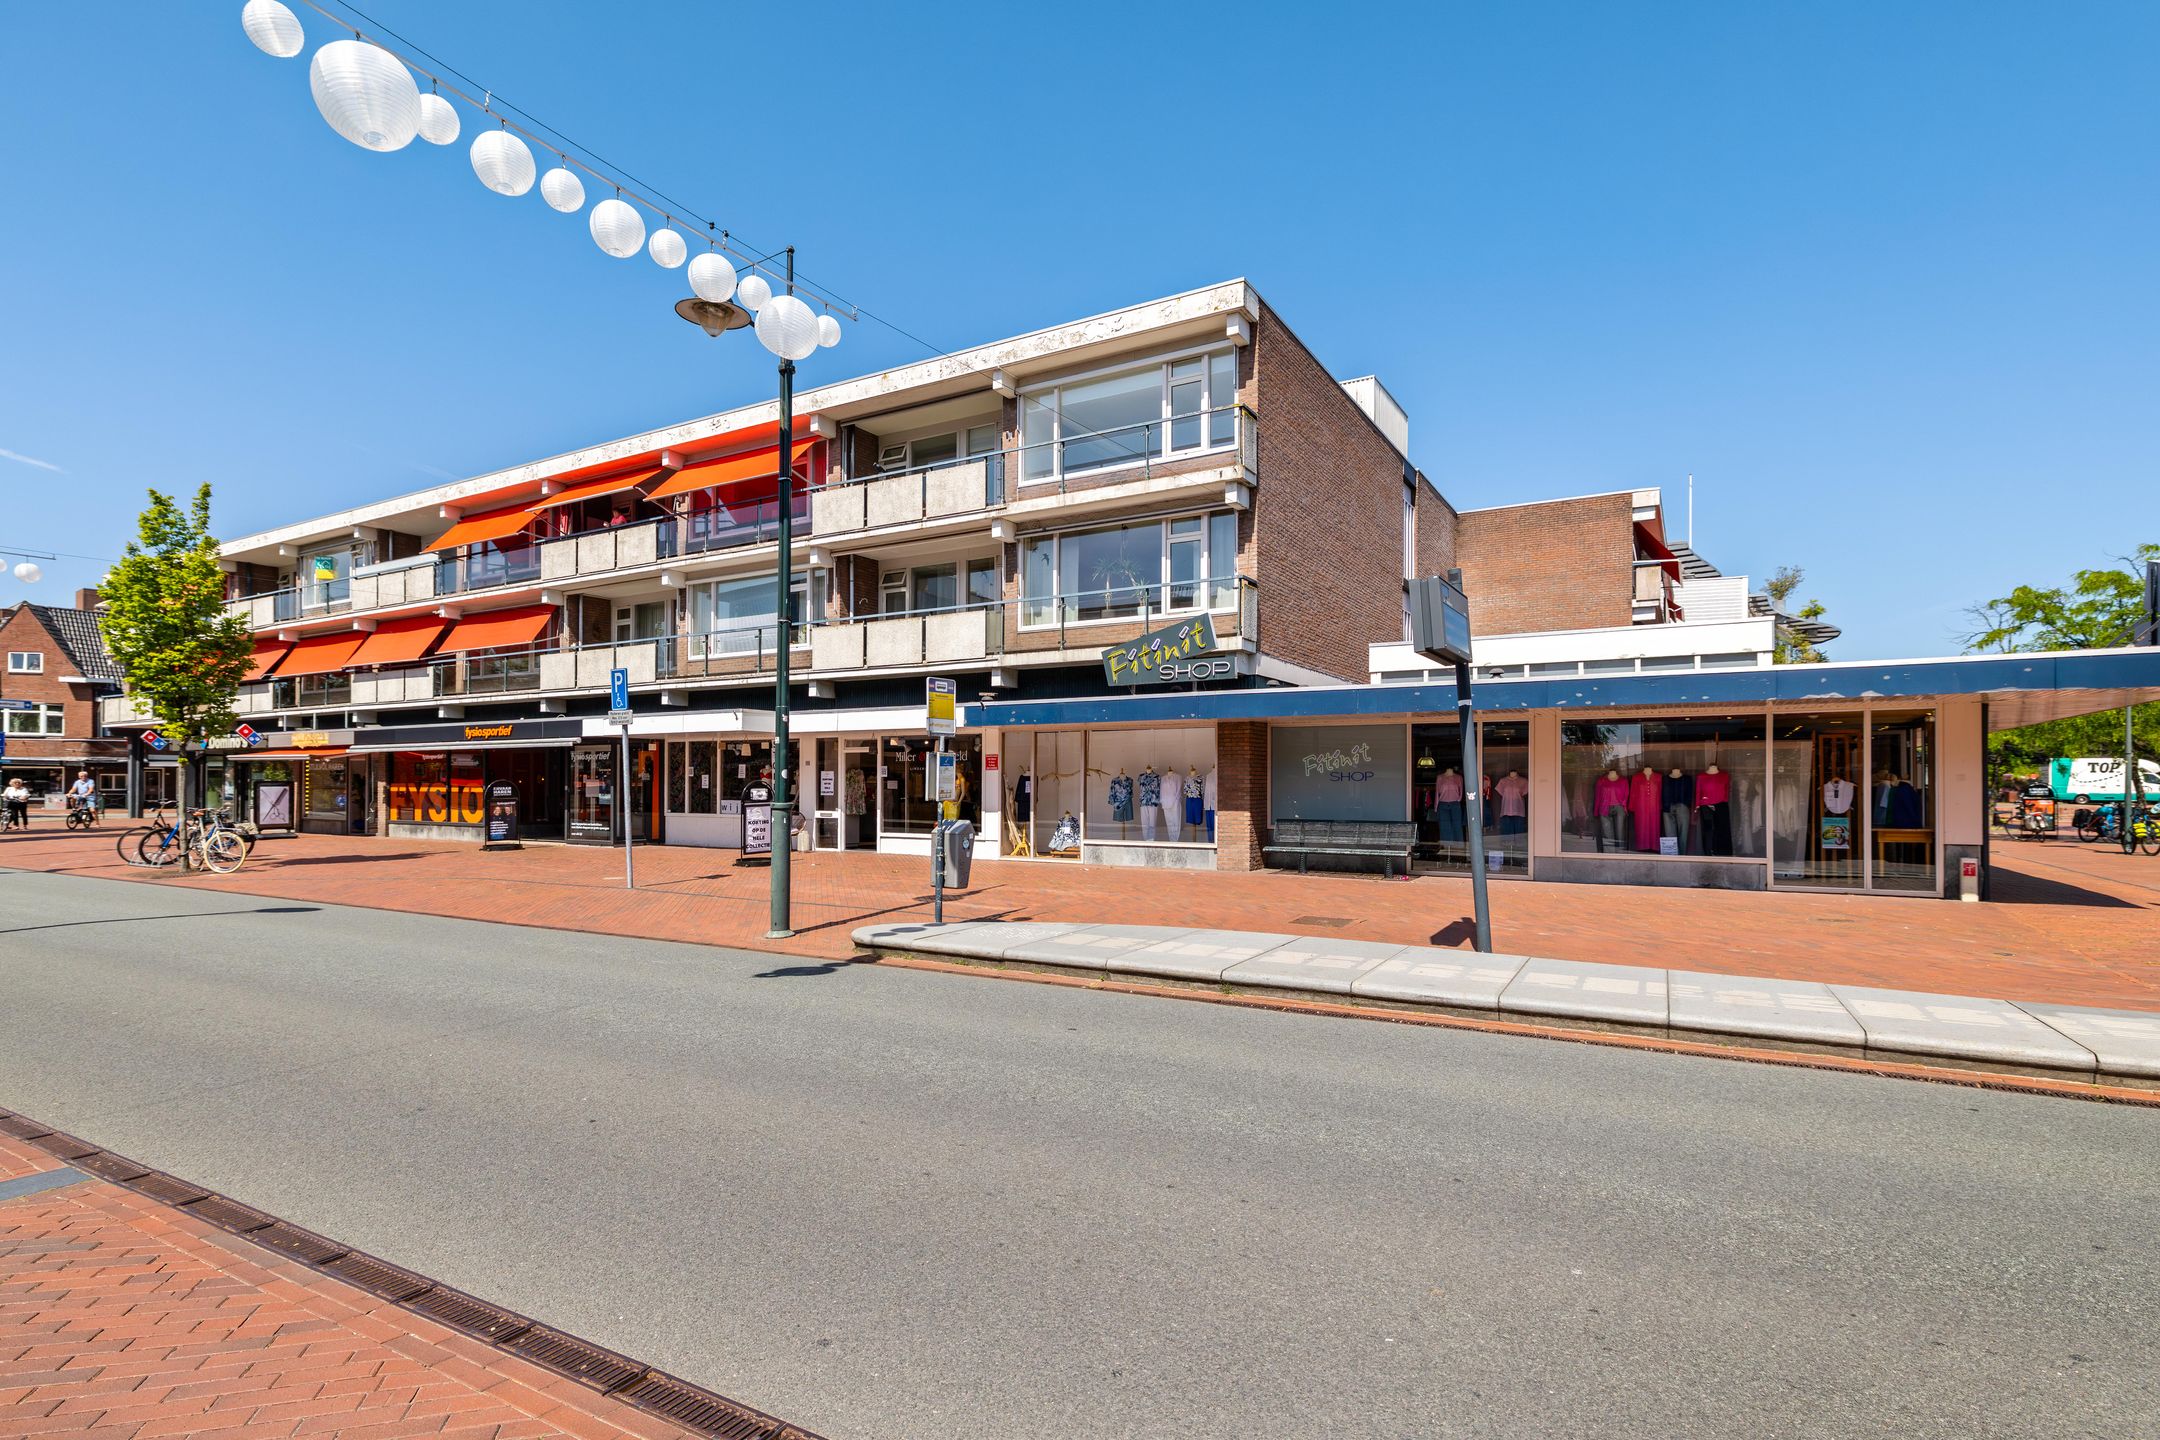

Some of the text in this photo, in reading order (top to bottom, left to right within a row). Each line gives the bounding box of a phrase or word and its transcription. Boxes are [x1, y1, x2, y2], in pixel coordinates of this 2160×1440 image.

[1108, 622, 1206, 684] Fitinit
[1160, 661, 1231, 681] SHOP
[614, 672, 623, 693] P
[465, 725, 512, 739] fysiosportief
[208, 736, 248, 749] Domino's
[570, 752, 610, 762] fysiosportief
[895, 751, 916, 762] Miller
[1302, 742, 1372, 777] Fitinit
[2088, 762, 2121, 773] TOP
[1329, 771, 1375, 782] SHOP
[390, 783, 484, 824] FYSIO
